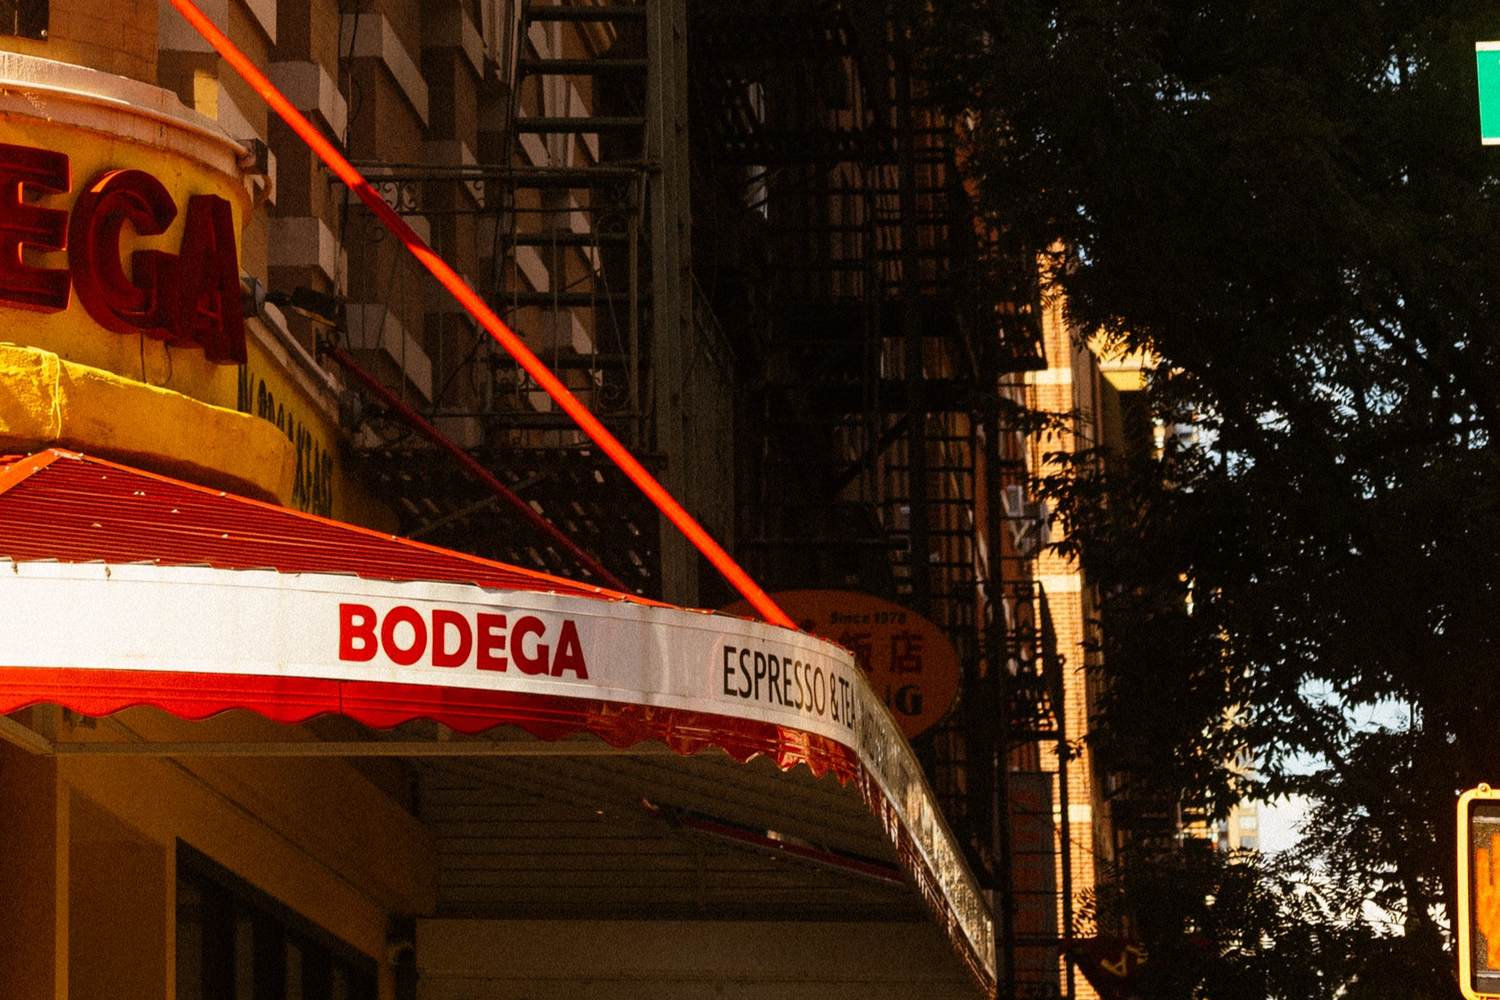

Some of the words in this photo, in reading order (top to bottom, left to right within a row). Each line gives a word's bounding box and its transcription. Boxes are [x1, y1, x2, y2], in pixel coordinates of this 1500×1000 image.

[338, 602, 589, 680] BODEGA
[830, 611, 871, 625] Since
[723, 645, 827, 717] ESPRESSO
[829, 672, 840, 723] &
